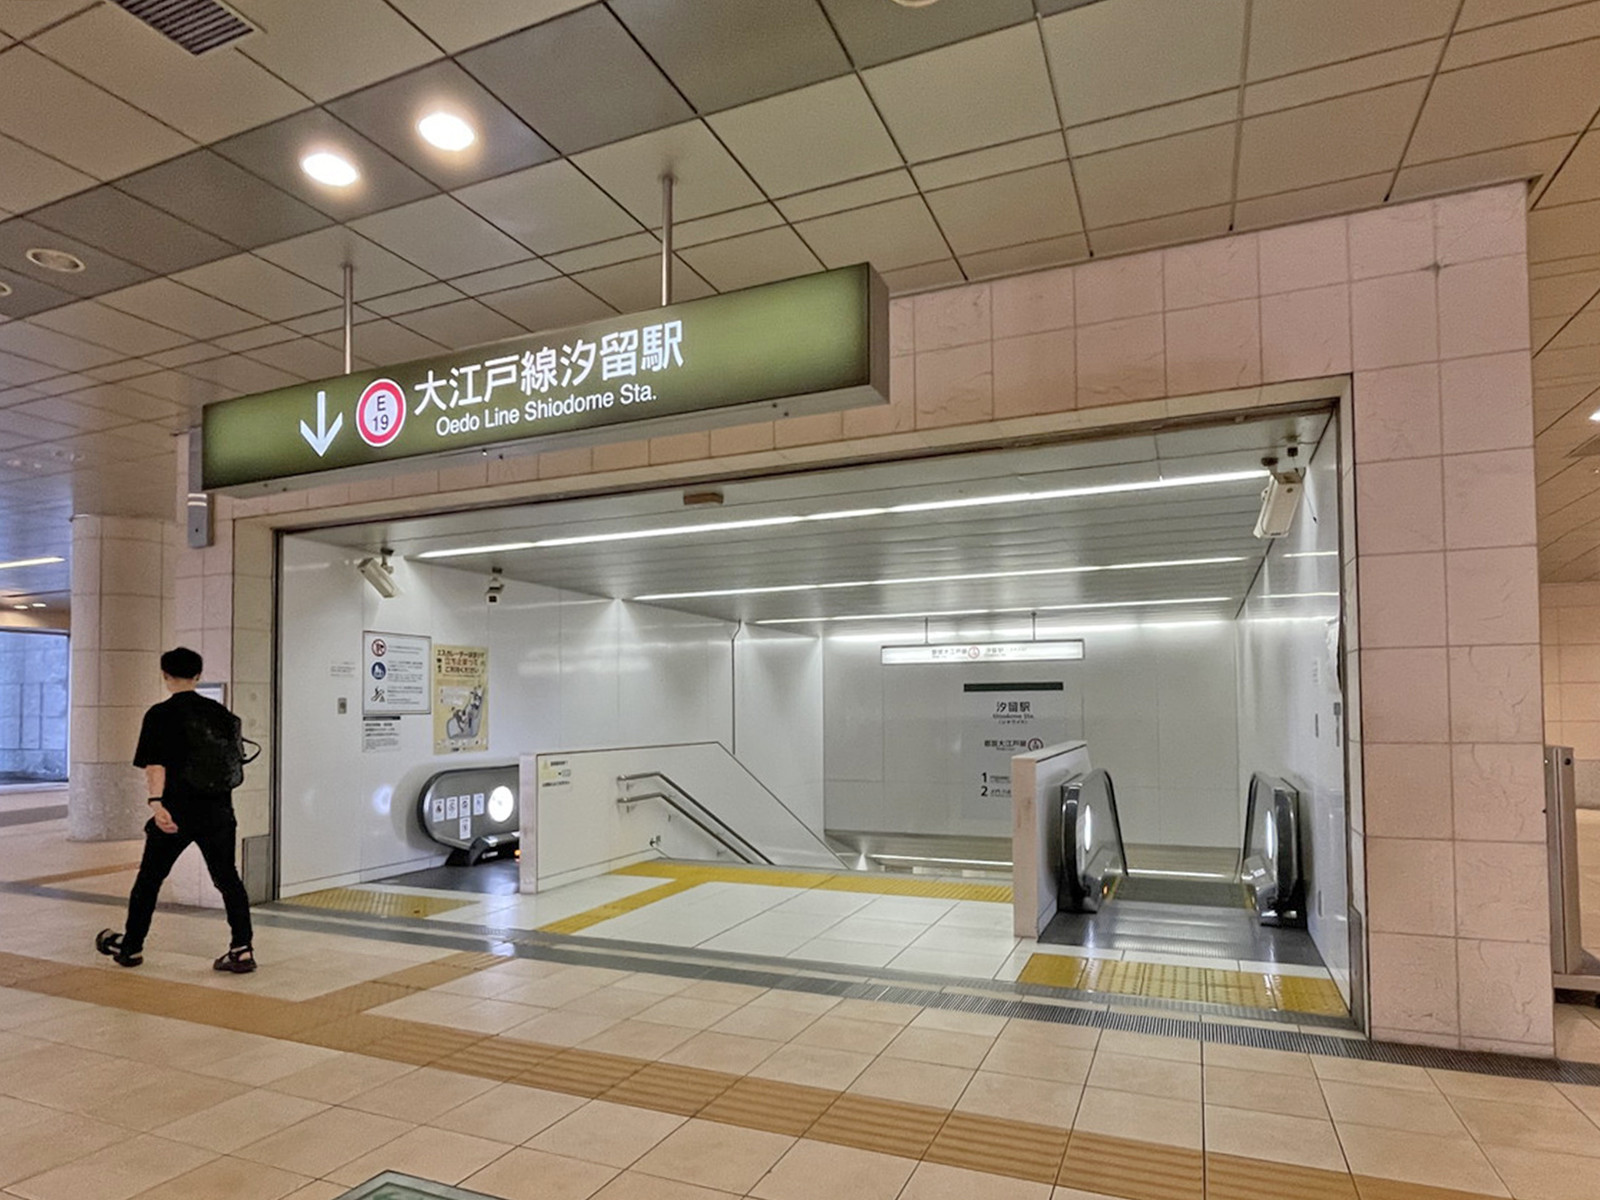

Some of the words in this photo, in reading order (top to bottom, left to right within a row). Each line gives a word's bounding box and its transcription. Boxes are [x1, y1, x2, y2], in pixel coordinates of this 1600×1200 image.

[414, 320, 684, 416] 大江戸線汐留駅
[376, 395, 387, 412] E
[436, 413, 480, 436] Oedo
[484, 406, 520, 428] Line
[524, 391, 614, 421] Shiodome
[620, 383, 657, 405] Sta.
[372, 414, 389, 431] 19
[996, 701, 1031, 713] 汐留駅
[981, 771, 987, 783] 1
[981, 785, 988, 797] 2
